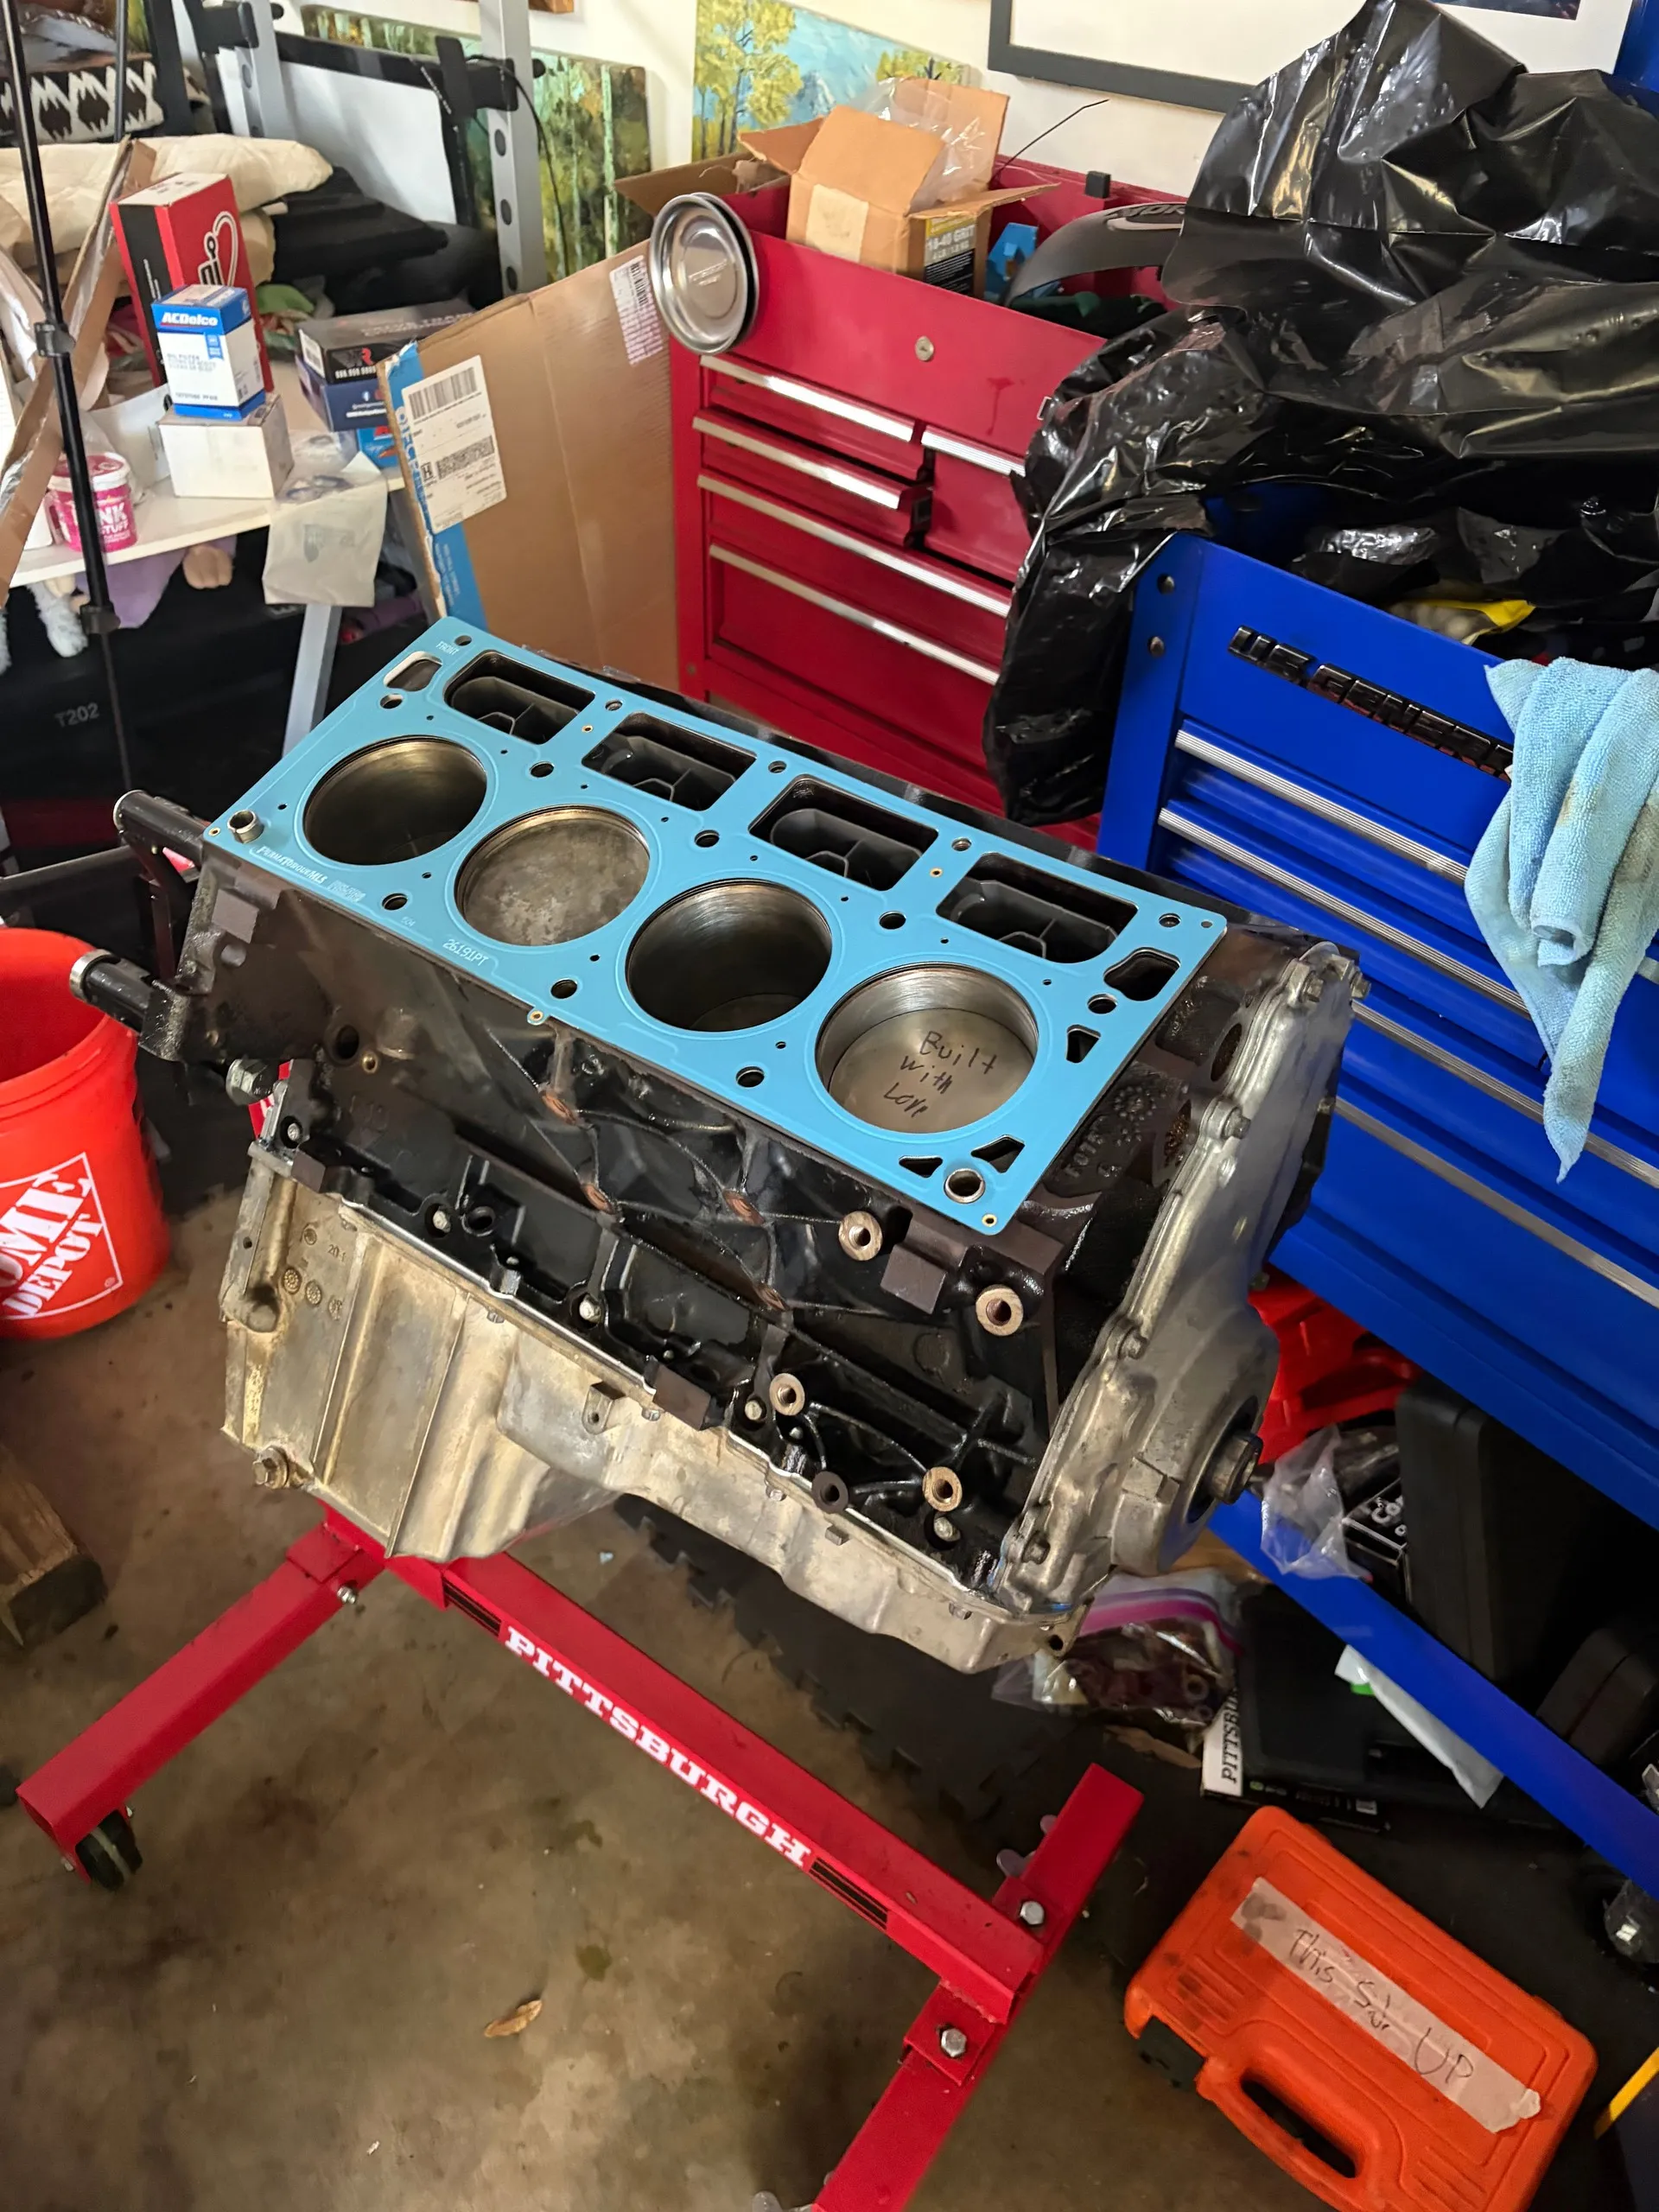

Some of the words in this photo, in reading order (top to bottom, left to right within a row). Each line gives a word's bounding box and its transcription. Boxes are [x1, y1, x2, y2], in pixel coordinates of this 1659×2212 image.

[161, 311, 219, 327] ACDelco
[99, 502, 128, 524] NK
[101, 520, 129, 534] TUFF
[54, 702, 100, 728] T202
[442, 938, 490, 966] 26191PT
[919, 1030, 998, 1075] Built
[2, 1213, 104, 1316] DEPOT
[504, 1625, 812, 1866] PITTSBURGH
[1221, 1687, 1239, 1784] PITTSBU
[1289, 1928, 1335, 1984] This
[1414, 2026, 1474, 2084] UP
